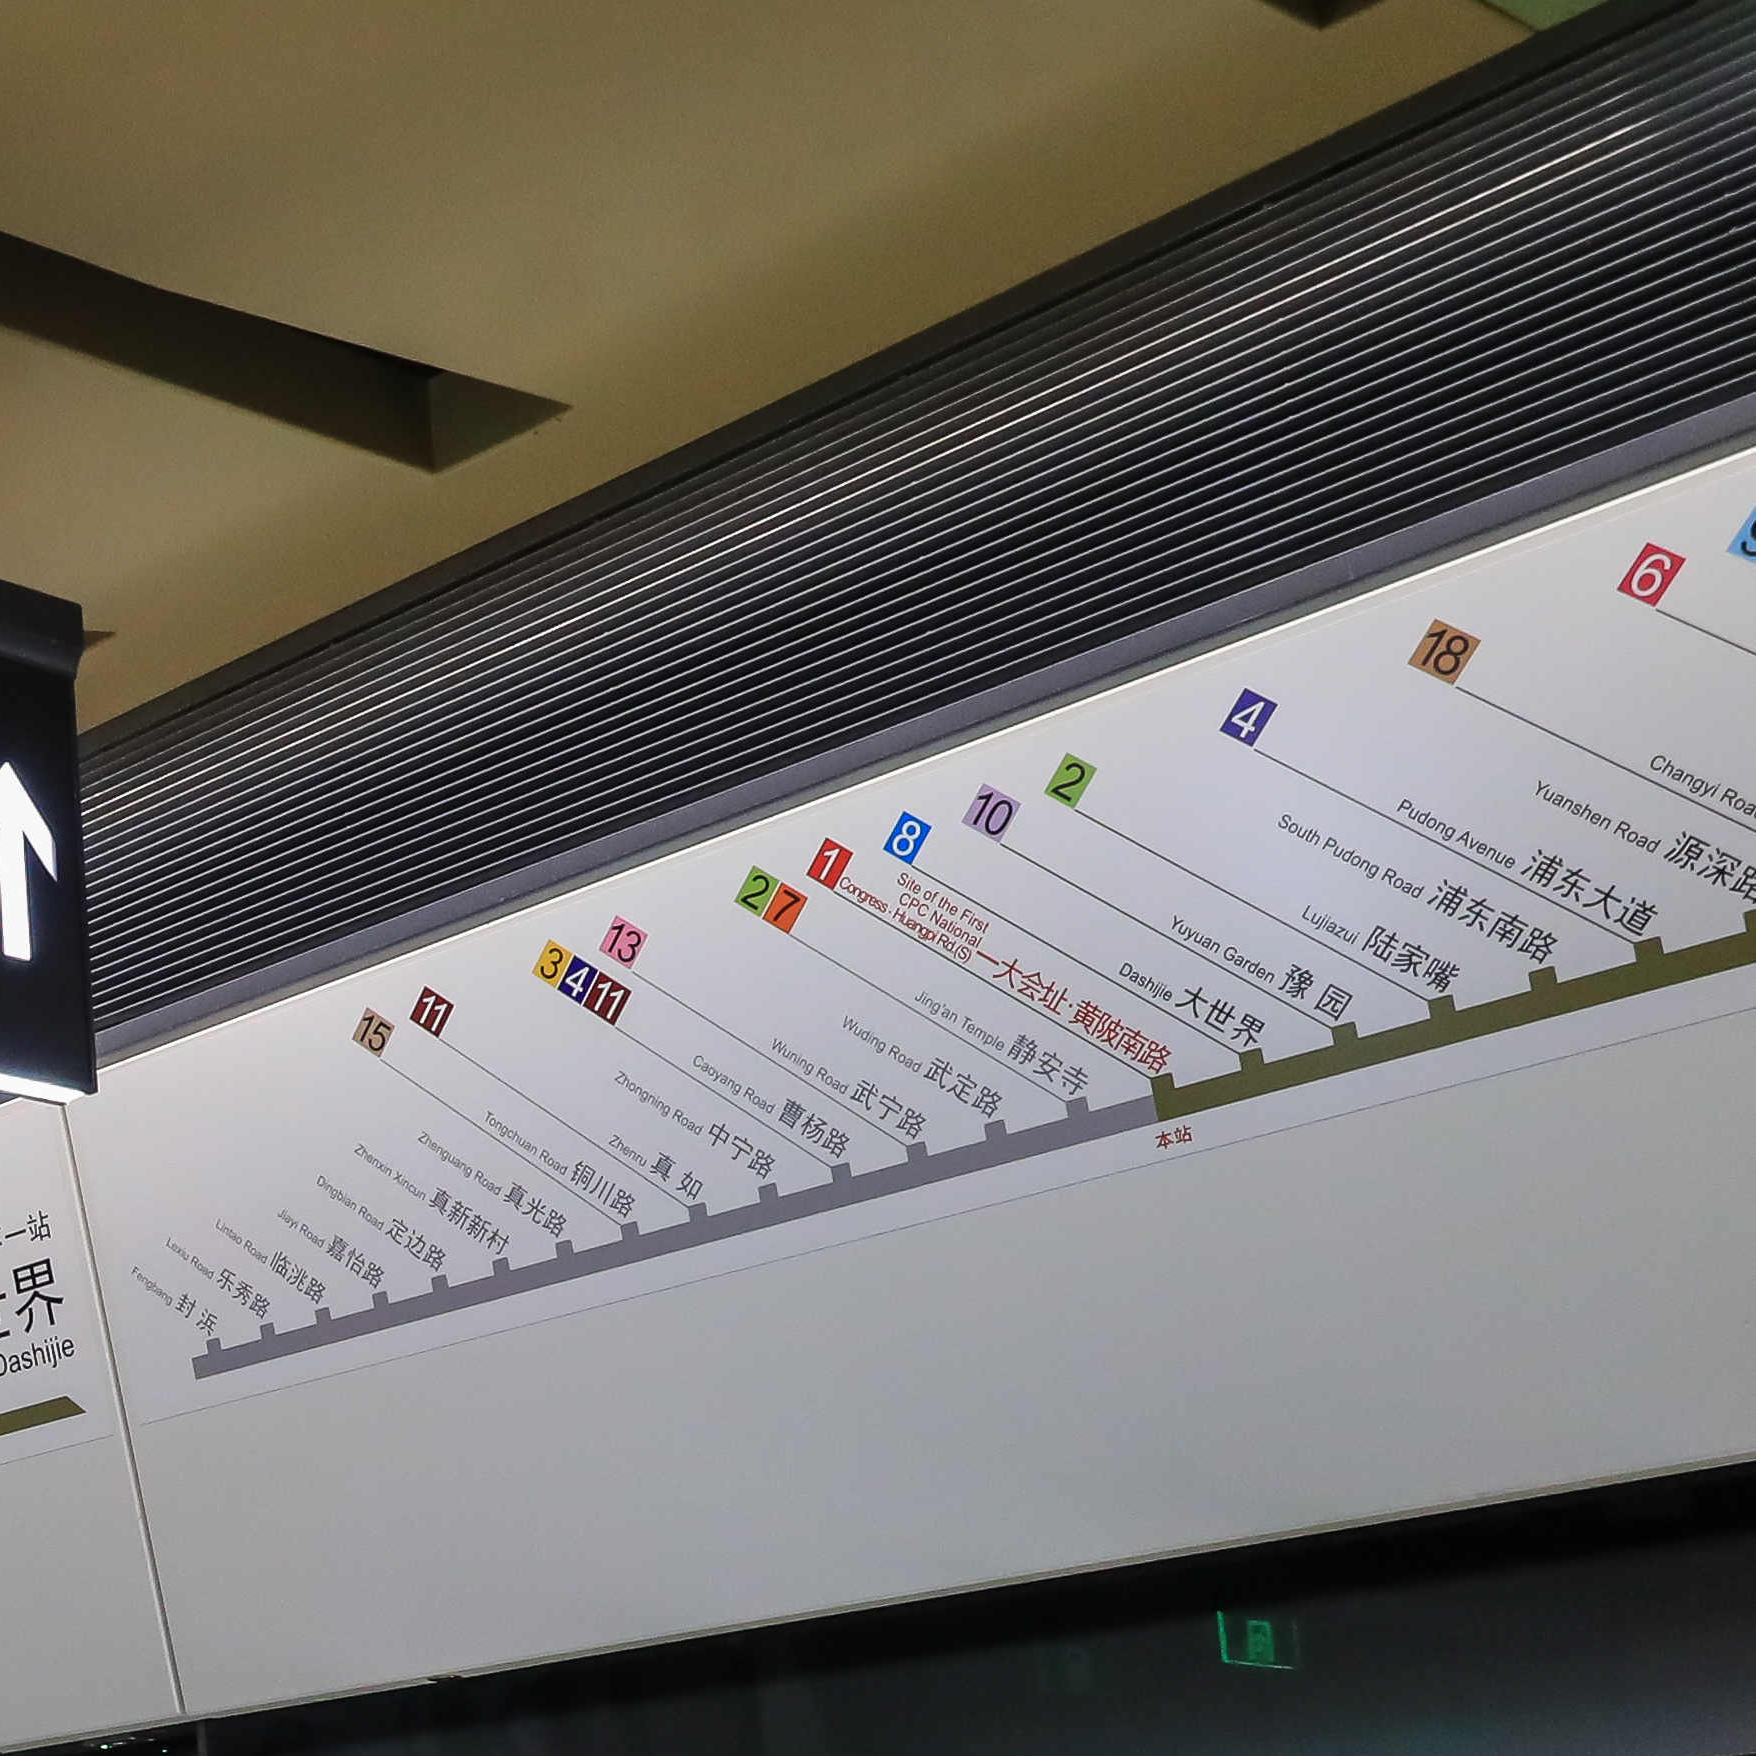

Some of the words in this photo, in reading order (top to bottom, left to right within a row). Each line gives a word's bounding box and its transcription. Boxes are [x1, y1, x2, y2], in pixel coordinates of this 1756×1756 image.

[1630, 554, 1671, 598] 6
[1419, 629, 1469, 675] 18
[1231, 699, 1264, 738] 4
[1052, 762, 1087, 804] 2
[1649, 754, 1721, 798] Changyi
[1719, 788, 1756, 820] Roa
[892, 820, 921, 857] 8
[972, 790, 1013, 836] 10
[1396, 798, 1458, 842] Pudong
[1457, 830, 1517, 869] Avenue
[1533, 780, 1611, 830] Yuanshen
[1613, 820, 1663, 854] Road
[818, 847, 841, 881] 1
[1278, 814, 1321, 847] South
[1321, 837, 1380, 880] Pudong
[1381, 868, 1425, 900] Road
[740, 874, 770, 911] 2
[772, 889, 801, 922] 7
[839, 876, 889, 914] Congress
[892, 908, 937, 943] Huangpi
[897, 872, 922, 895] Site
[923, 889, 939, 904] of
[938, 896, 958, 916] the
[959, 907, 990, 934] First
[898, 893, 929, 918] CPC
[929, 910, 983, 949] National
[1426, 878, 1559, 965] 浦东南路
[1520, 849, 1659, 937] 浦东大道
[609, 923, 641, 963] 13
[1170, 915, 1221, 954] Yuyuan
[1223, 945, 1276, 984] Garden
[1301, 904, 1361, 946] Lujiazui
[540, 947, 563, 980] 3
[567, 966, 589, 998] 4
[593, 981, 626, 1020] 11
[1119, 962, 1173, 1002] Dashijie
[1361, 925, 1461, 994] 陆家嘴
[421, 995, 447, 1032] 11
[976, 950, 1173, 1075] 一大会址·黄陂南路
[1174, 986, 1266, 1048] 大世界
[1278, 962, 1353, 1022] 豫园
[360, 1014, 391, 1051] 15
[842, 1015, 886, 1054] Wuding
[888, 1044, 923, 1074] Road
[914, 991, 959, 1025] Jing'an
[961, 1017, 1006, 1052] Temple
[692, 1055, 742, 1095] Caoyang
[743, 1087, 776, 1114] Road
[771, 1038, 814, 1075] Wuning
[816, 1066, 849, 1095] Road
[923, 1056, 1003, 1119] 武定路
[1006, 1033, 1089, 1097] 静安寺
[614, 1070, 671, 1117] Zhongning
[672, 1108, 704, 1136] Road
[778, 1098, 850, 1159] 曹杨路
[849, 1079, 927, 1140] 武宁路
[417, 1131, 473, 1178] Zhenguang
[474, 1170, 502, 1196] Road
[484, 1110, 538, 1158] Tongchuan
[539, 1148, 568, 1175] Road
[608, 1134, 647, 1168] Zhenru
[708, 1122, 776, 1180] 中宁路
[1155, 1124, 1194, 1150] 本站
[354, 1143, 392, 1178] Zhenxin
[393, 1171, 426, 1201] Xincun
[570, 1160, 636, 1219] 铜川路
[650, 1151, 703, 1201] 真如
[316, 1175, 357, 1211] Dingbian
[358, 1206, 385, 1231] Road
[429, 1187, 510, 1256] 真新新村
[503, 1181, 567, 1238] 真光路
[215, 1219, 243, 1245] Lintao
[243, 1239, 268, 1264] Road
[299, 1223, 325, 1248] Road
[326, 1235, 385, 1289] 嘉怡路
[385, 1218, 447, 1272] 定边路
[190, 1256, 215, 1280] Road
[216, 1268, 270, 1319] 乐秀路
[269, 1251, 326, 1304] 临洮路
[175, 1292, 218, 1336] 封浜
